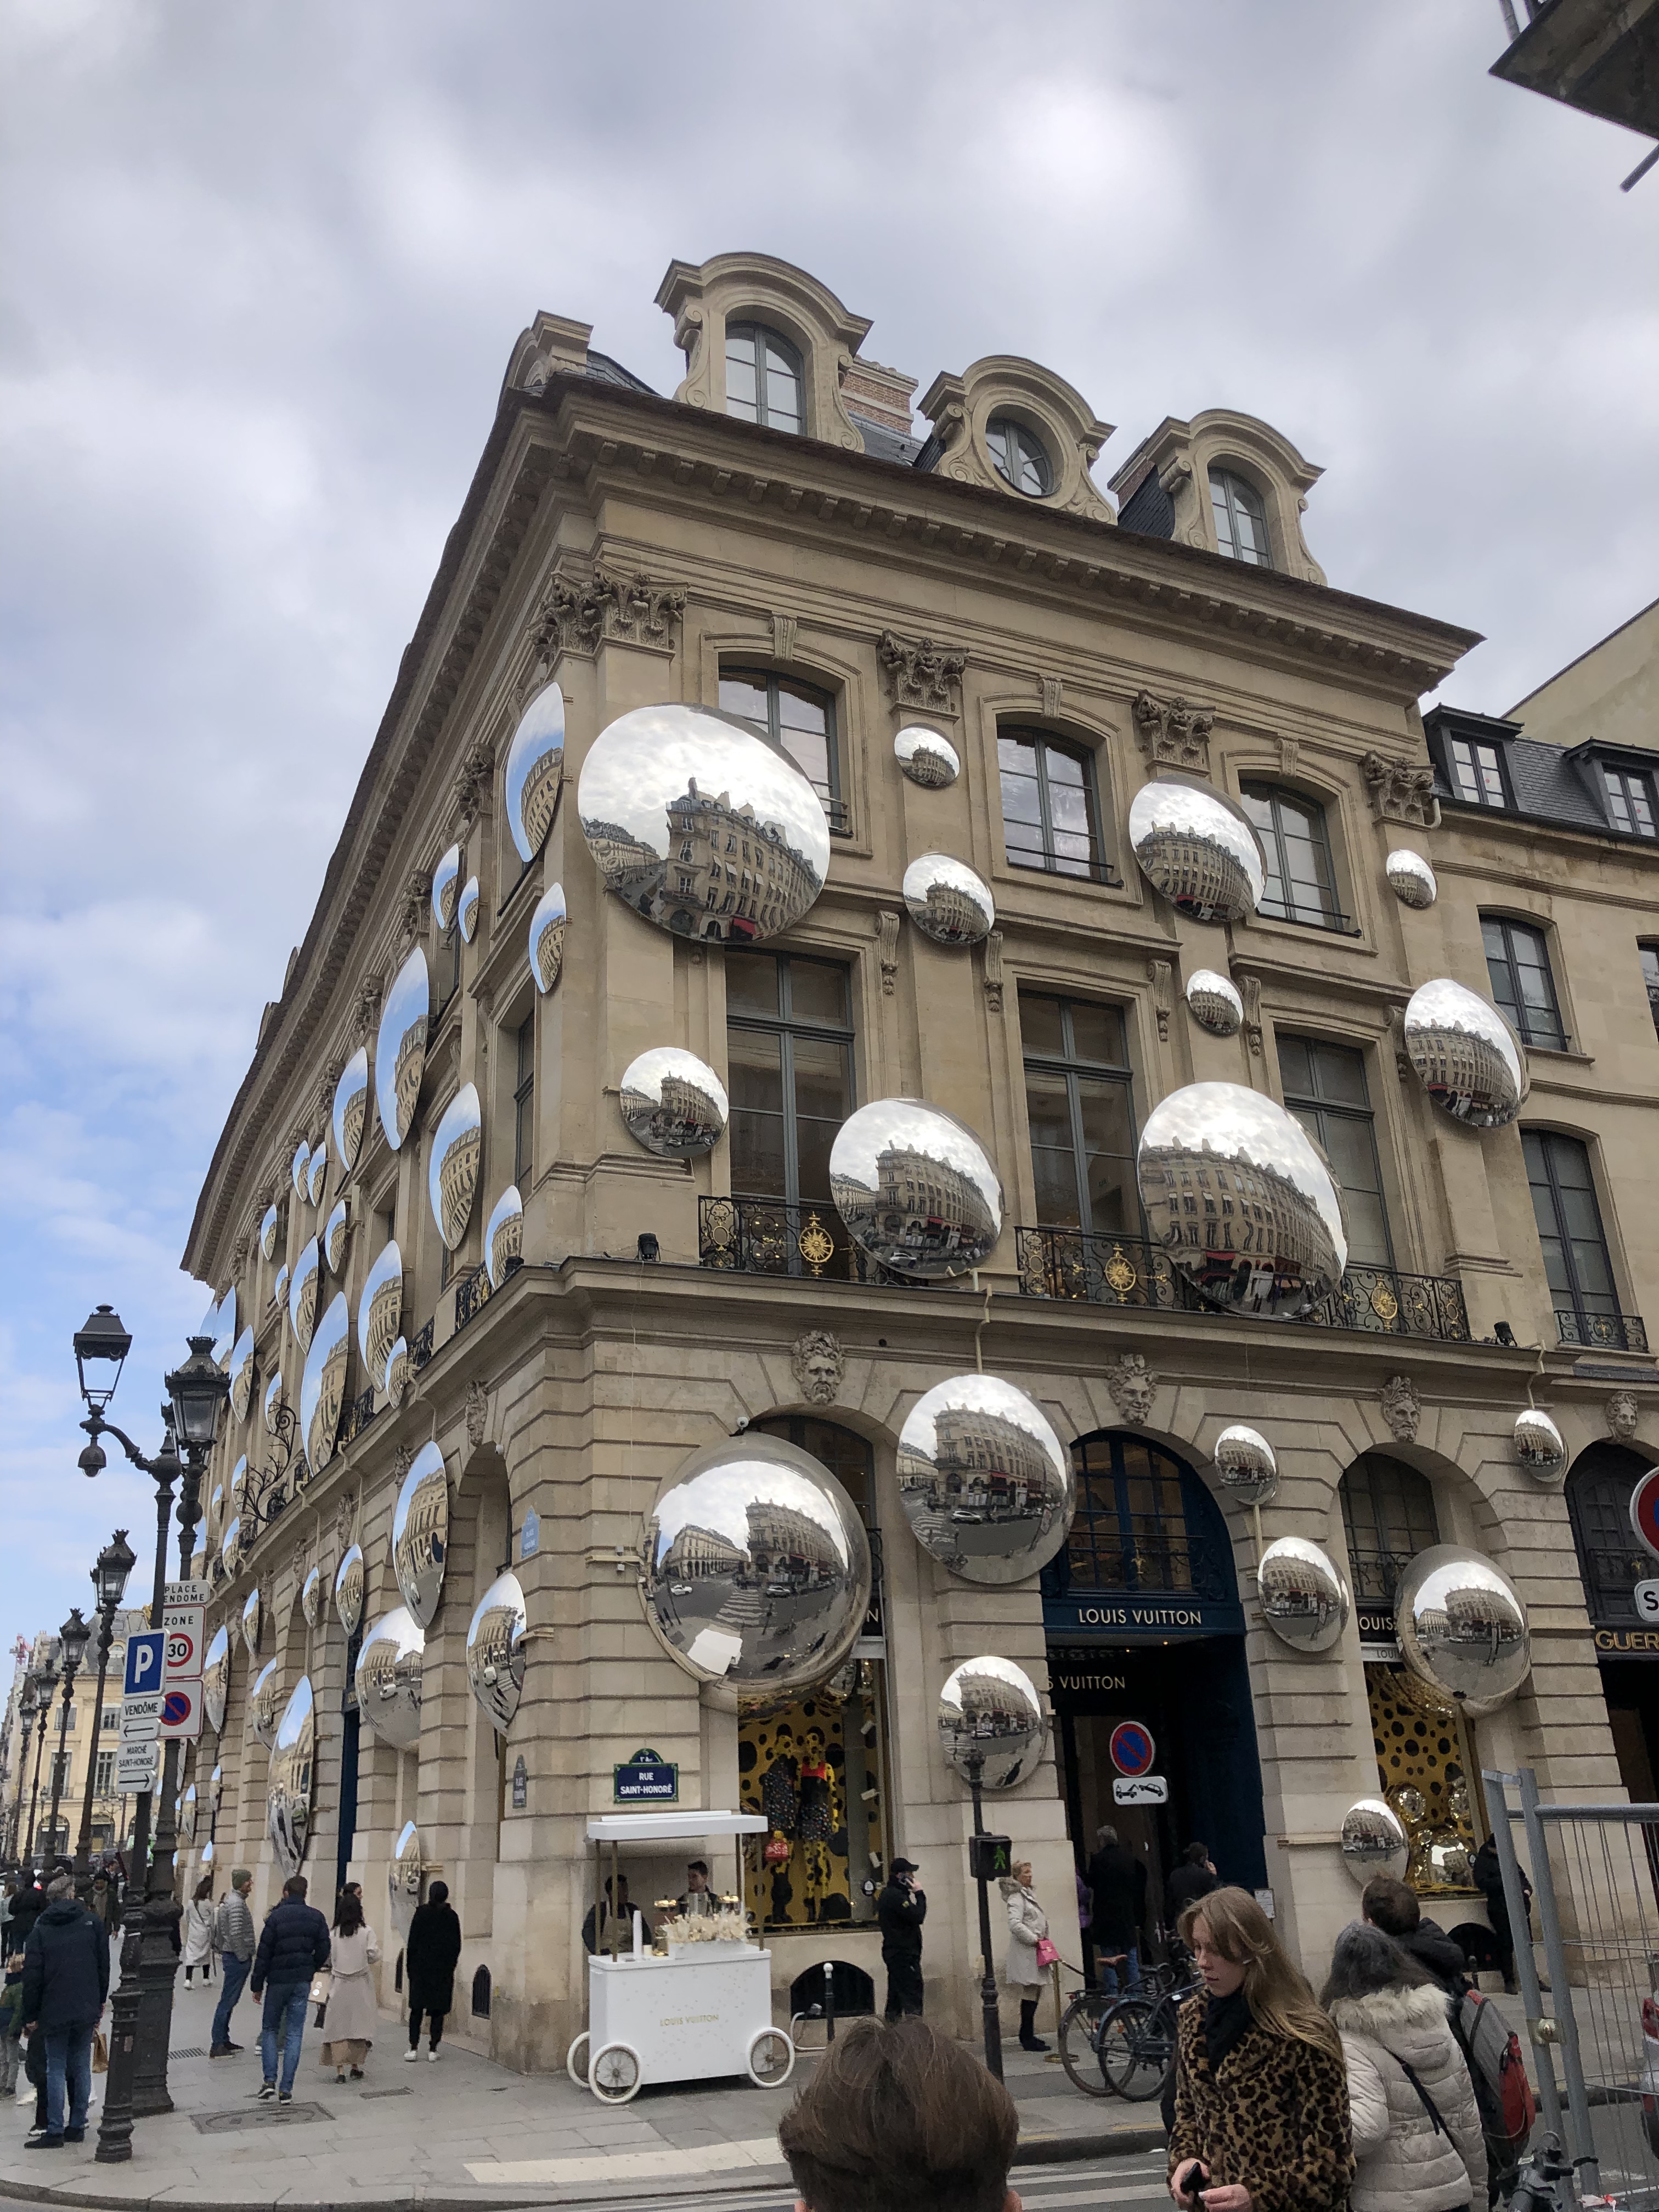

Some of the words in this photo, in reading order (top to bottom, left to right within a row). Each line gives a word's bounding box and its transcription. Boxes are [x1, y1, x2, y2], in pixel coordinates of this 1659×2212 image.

[165, 1585, 197, 1594] PLACE
[164, 1594, 205, 1602] ENDOME
[1643, 1591, 1658, 1611] S
[164, 1616, 194, 1626] ZONE
[1079, 1609, 1126, 1623] LOUIS
[1132, 1610, 1201, 1624] VUITTON
[1359, 1617, 1393, 1630] OUIS
[1595, 1630, 1659, 1650] GUER
[168, 1643, 187, 1657] 30
[1376, 1649, 1399, 1658] LOUI
[134, 1644, 154, 1684] P
[1059, 1675, 1125, 1690] VUITTON
[125, 1702, 158, 1716] VENDÔME
[639, 1772, 654, 1781] RUE
[620, 1784, 673, 1795] SAINT-HONORÉ
